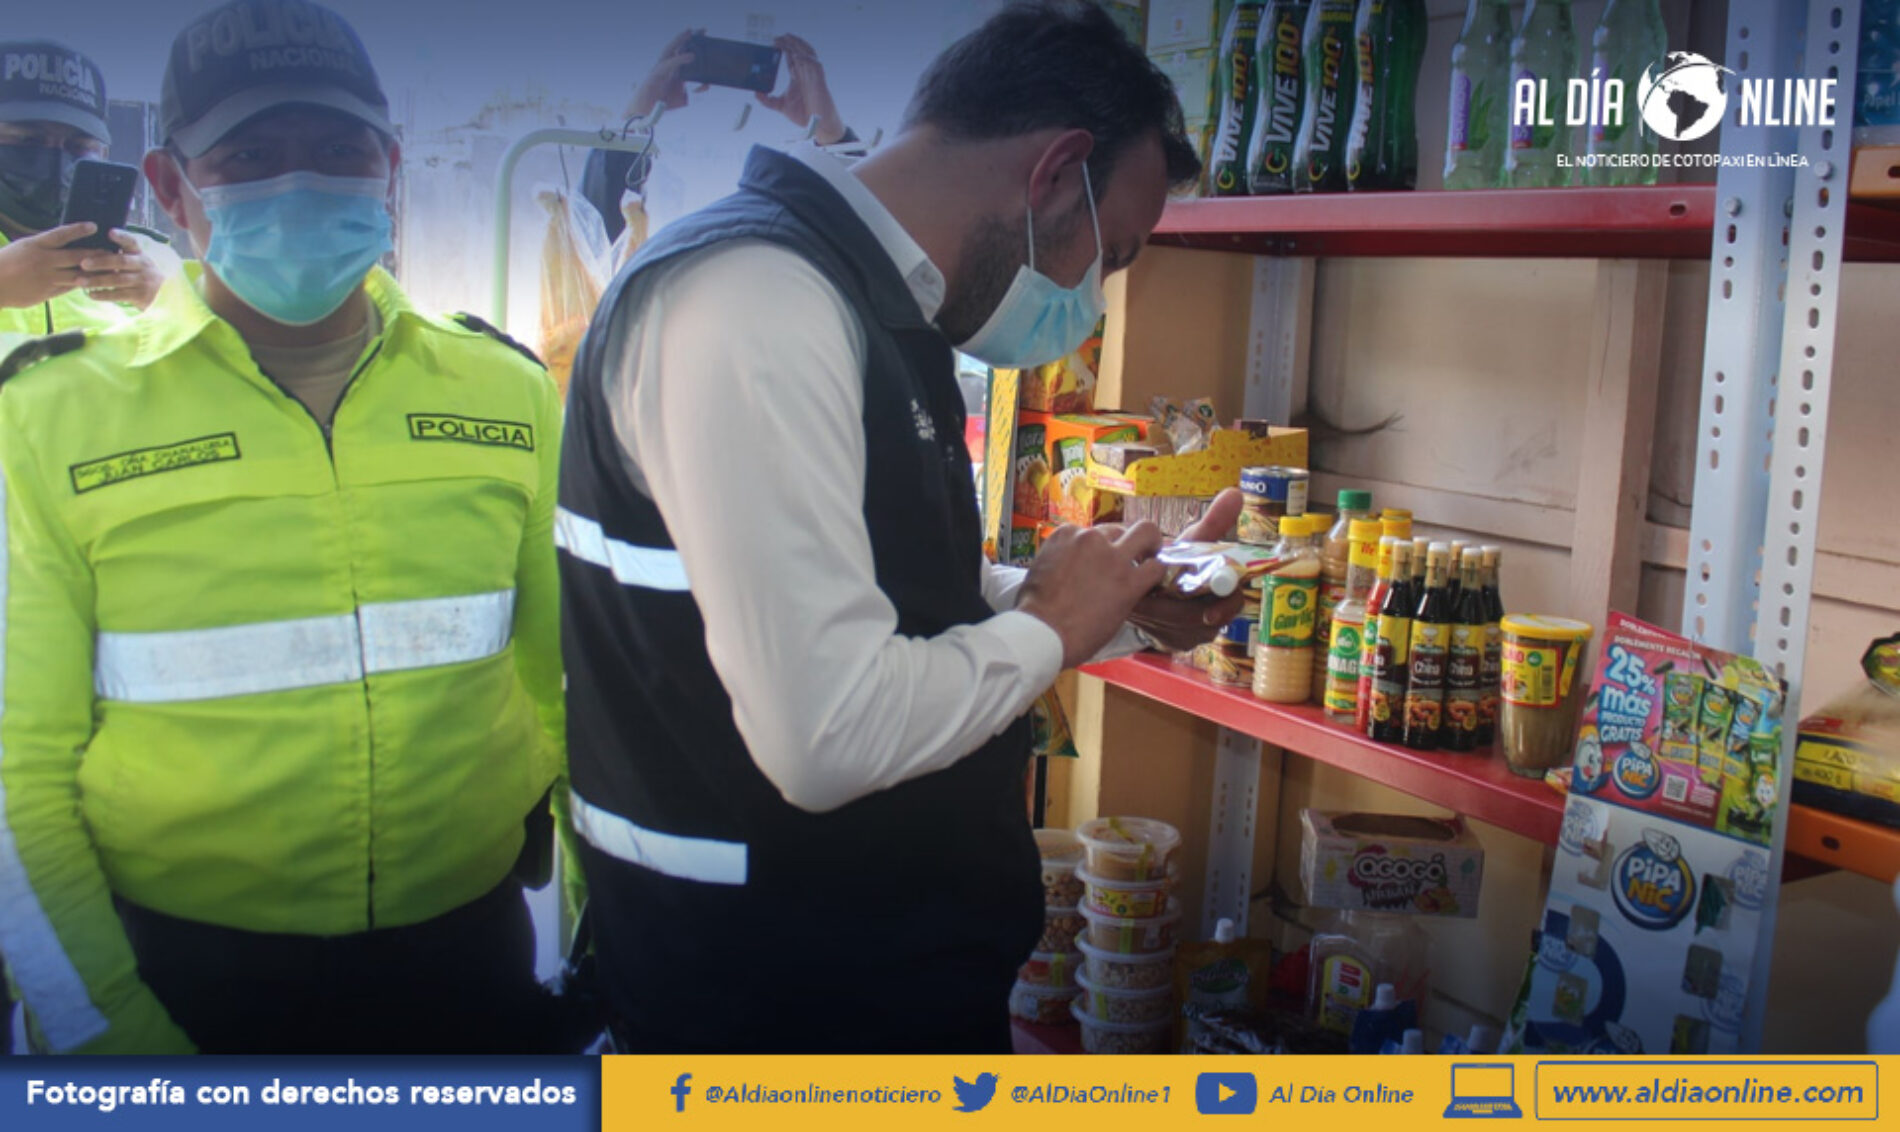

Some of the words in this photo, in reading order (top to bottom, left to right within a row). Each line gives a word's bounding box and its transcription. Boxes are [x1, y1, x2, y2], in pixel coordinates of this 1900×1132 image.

[416, 420, 528, 446] POLICIA
[1609, 644, 1656, 696] 25%
[1602, 685, 1652, 717] más
[1600, 724, 1644, 743] GRATIS
